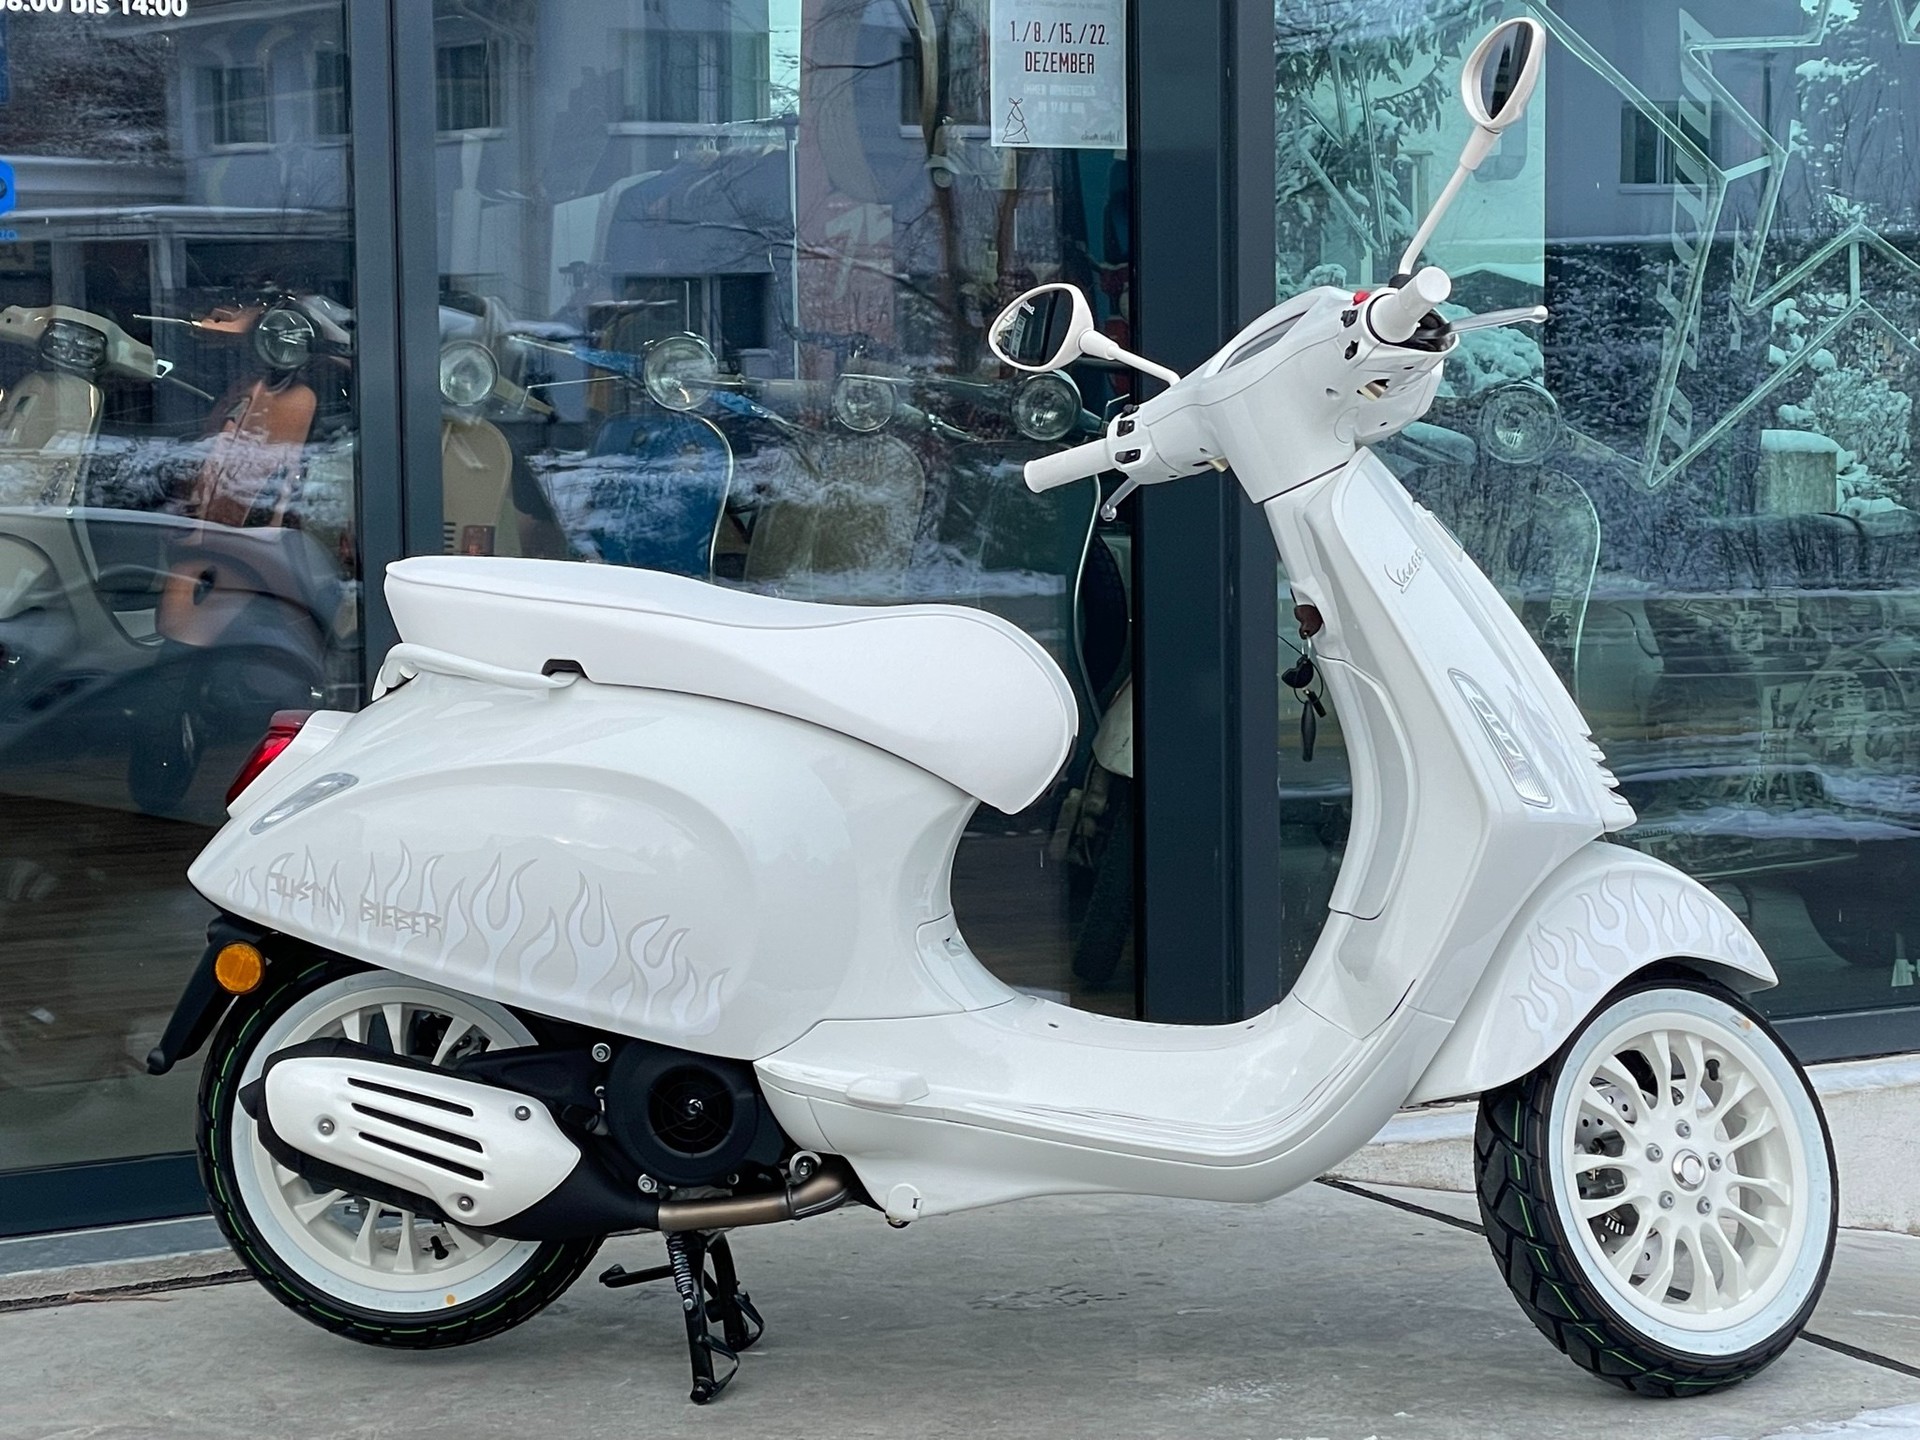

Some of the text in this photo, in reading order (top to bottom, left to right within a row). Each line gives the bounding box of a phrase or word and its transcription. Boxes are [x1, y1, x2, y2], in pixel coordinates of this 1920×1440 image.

[120, 0, 188, 17] 14:00
[1025, 51, 1095, 74] DEZEMBER
[267, 872, 442, 942] JUSTIN BIEBER
